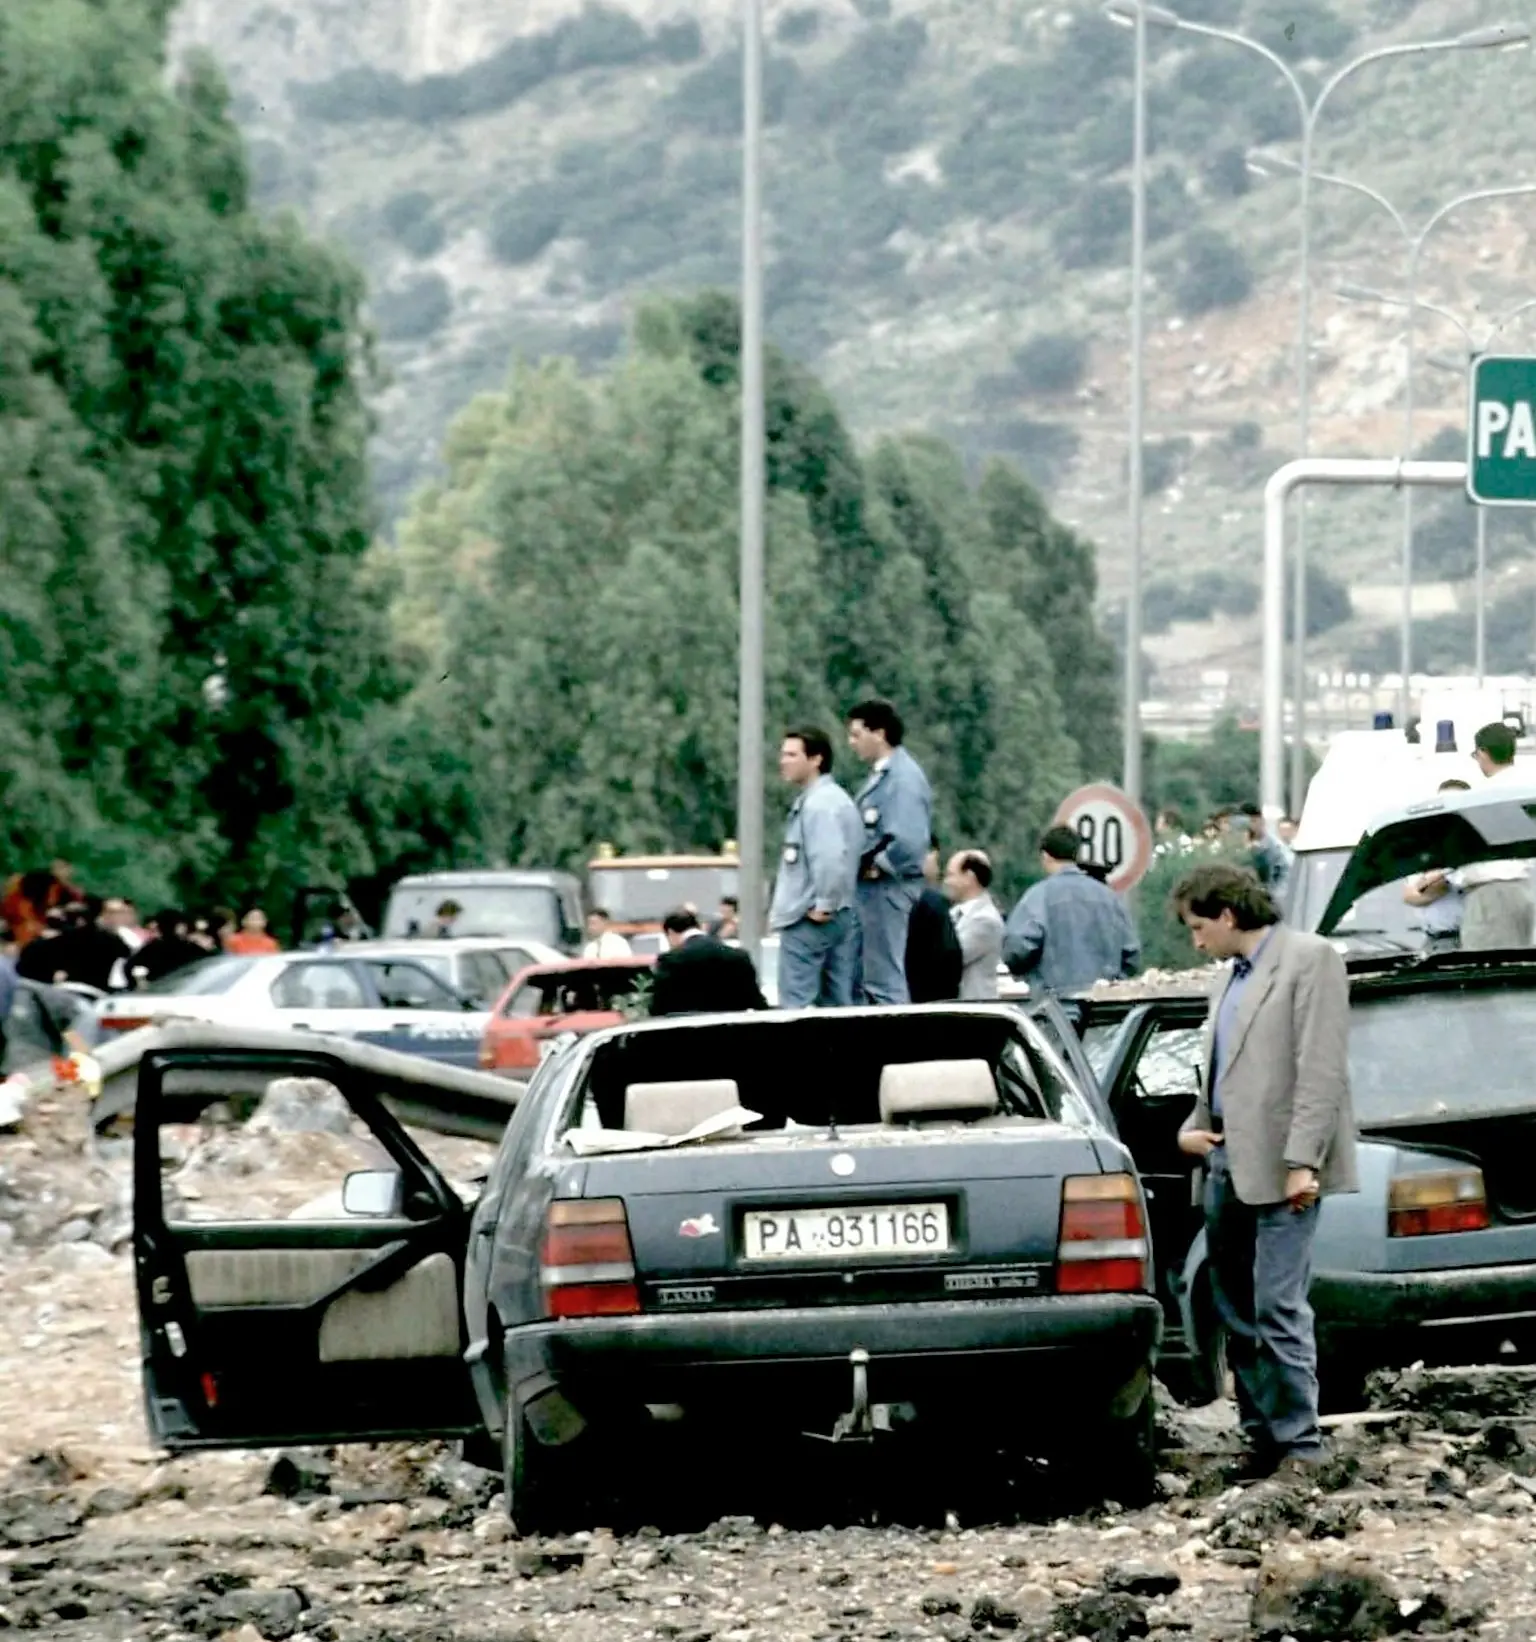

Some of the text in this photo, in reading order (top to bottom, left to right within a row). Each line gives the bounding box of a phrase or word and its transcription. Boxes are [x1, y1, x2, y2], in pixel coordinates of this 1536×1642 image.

[1077, 814, 1122, 868] 80
[759, 1218, 802, 1251] PA
[827, 1210, 939, 1249] 931166
